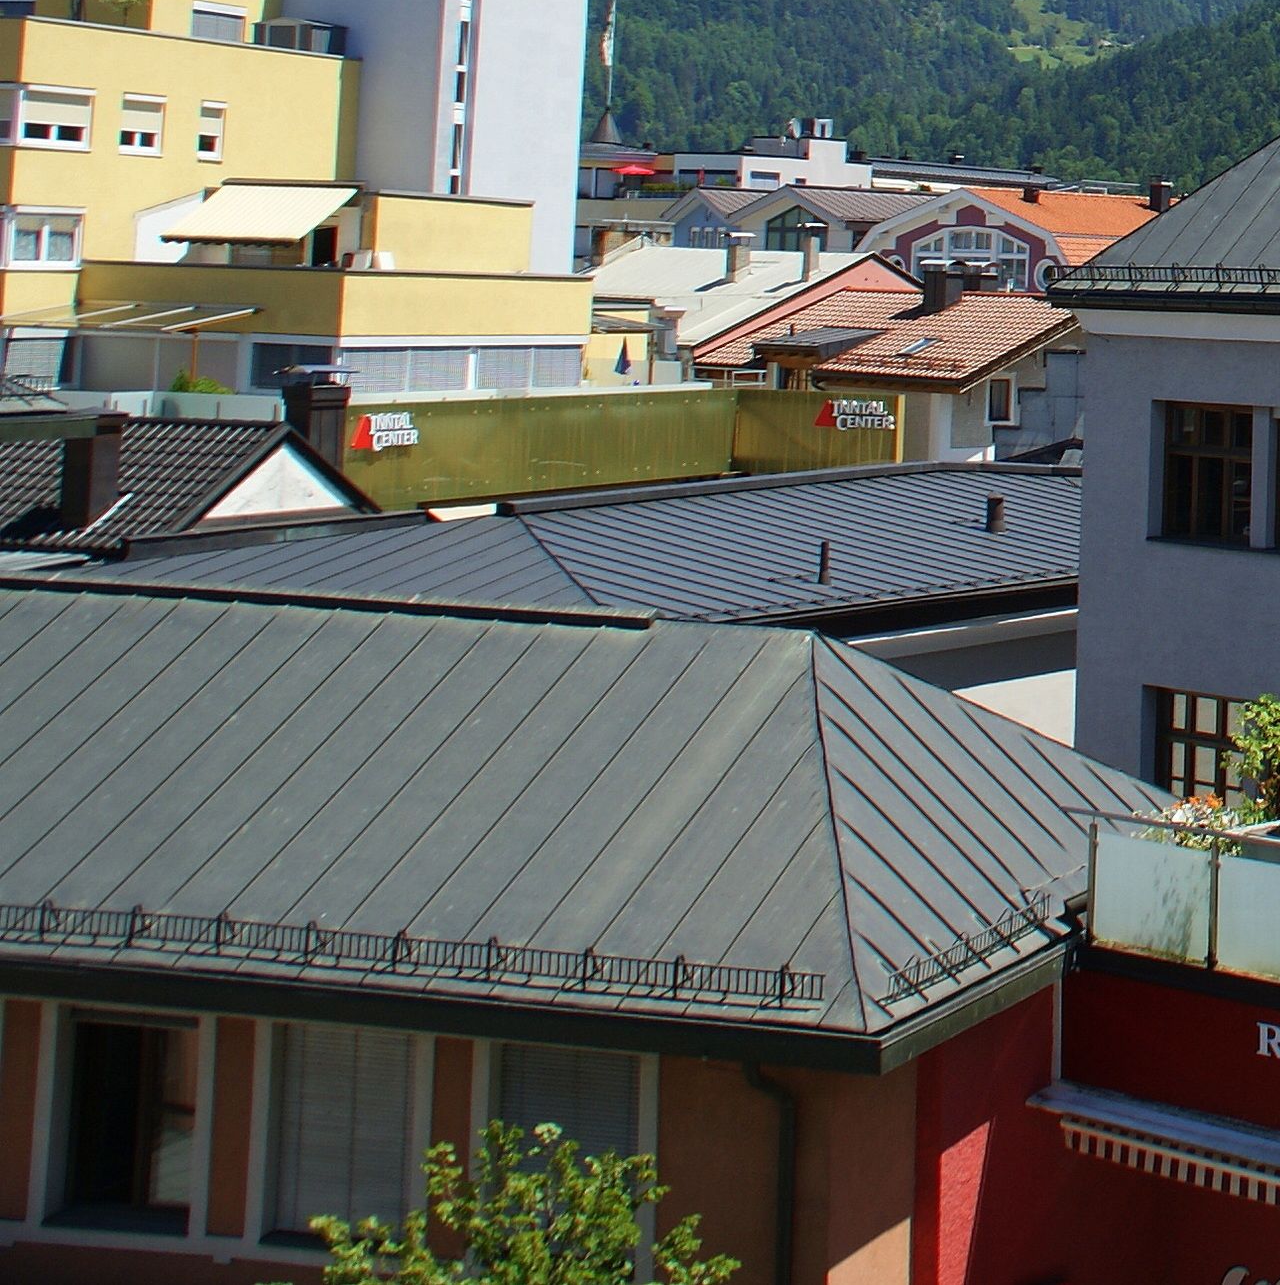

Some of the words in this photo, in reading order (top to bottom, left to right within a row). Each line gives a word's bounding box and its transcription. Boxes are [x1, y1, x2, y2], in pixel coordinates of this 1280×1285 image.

[832, 399, 888, 417] INNTAL
[369, 412, 413, 435] INNTAL
[836, 415, 895, 431] CENTER
[372, 429, 419, 452] CENTER
